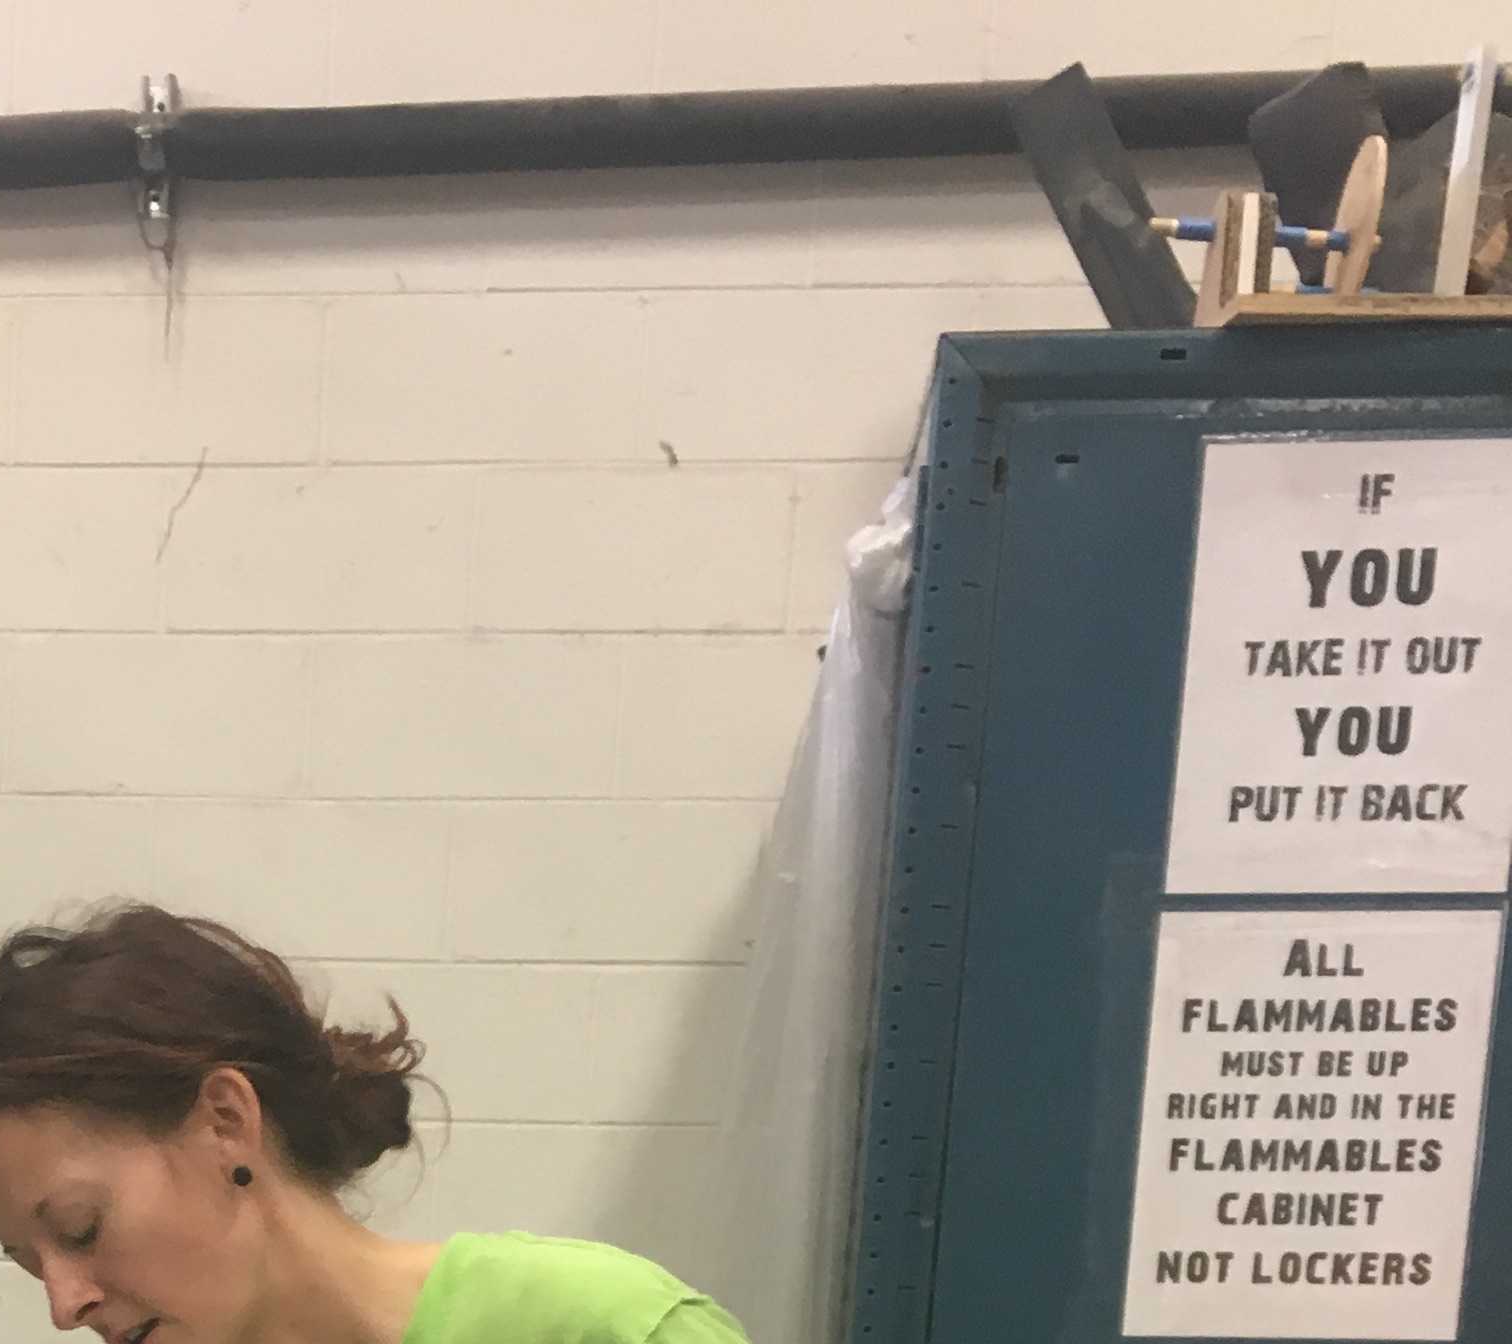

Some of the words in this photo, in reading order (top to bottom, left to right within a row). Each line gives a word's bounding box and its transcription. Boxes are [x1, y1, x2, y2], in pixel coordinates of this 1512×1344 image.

[1359, 474, 1395, 514] IF
[1302, 547, 1437, 608] YOU
[1245, 639, 1344, 676] TAKE
[1357, 639, 1391, 675] IT
[1406, 637, 1482, 673] OUT
[1296, 706, 1413, 757] YOU
[1228, 786, 1302, 822] PUT
[1315, 785, 1347, 822] IT
[1360, 784, 1468, 821] BACK
[1283, 939, 1364, 977] ALL
[1181, 998, 1459, 1033] FLAMMABLES
[1220, 1051, 1304, 1076] MUST
[1317, 1051, 1353, 1077] BE
[1368, 1051, 1409, 1077] UP
[1167, 1093, 1260, 1119] RIGHT
[1274, 1093, 1336, 1119] AND
[1351, 1093, 1382, 1119] IN
[1399, 1094, 1455, 1119] THE
[1169, 1139, 1443, 1171] FLAMMABLES
[1217, 1193, 1383, 1226] CABINET
[1156, 1251, 1234, 1284] NOT
[1252, 1252, 1432, 1285] LOCKERS
